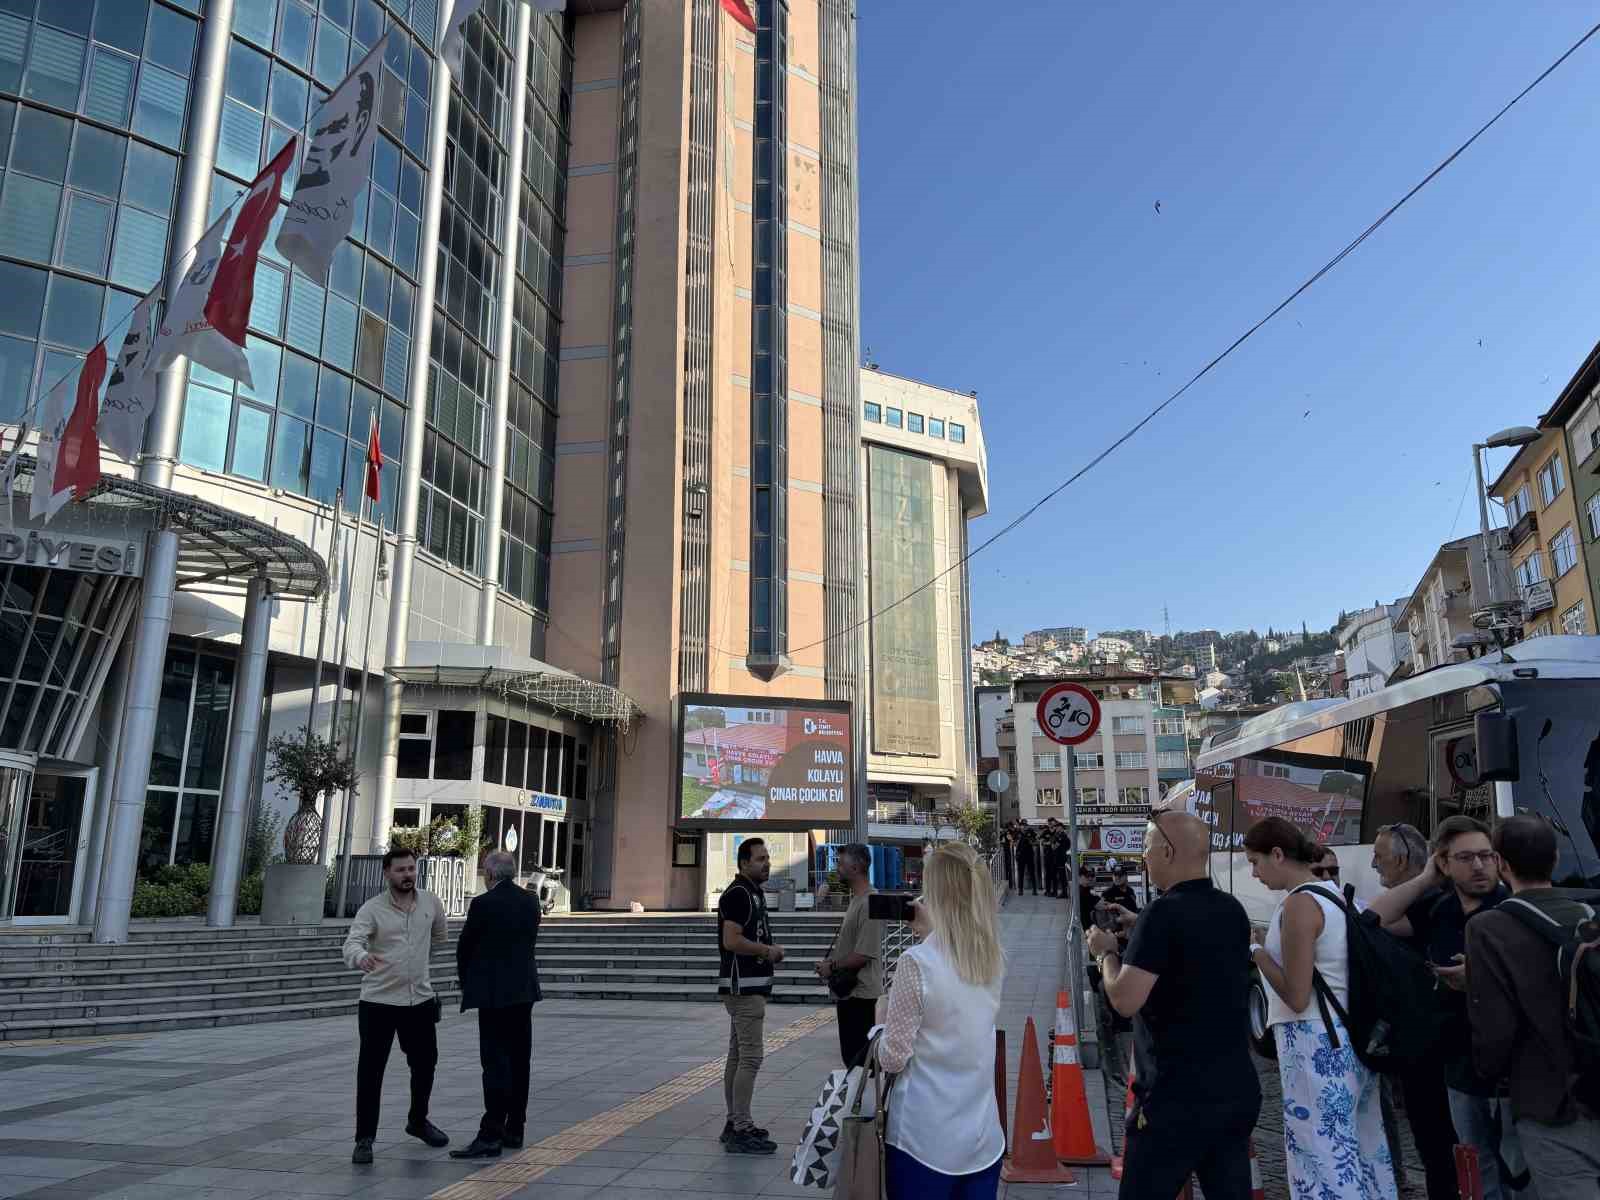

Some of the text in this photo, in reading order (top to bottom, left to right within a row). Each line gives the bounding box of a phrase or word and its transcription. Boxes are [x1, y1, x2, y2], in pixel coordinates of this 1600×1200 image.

[814, 750, 843, 764] HAVVA
[808, 769, 843, 784] KOLAYLI
[770, 787, 844, 804] ÇINAR ÇOCUK EVİ
